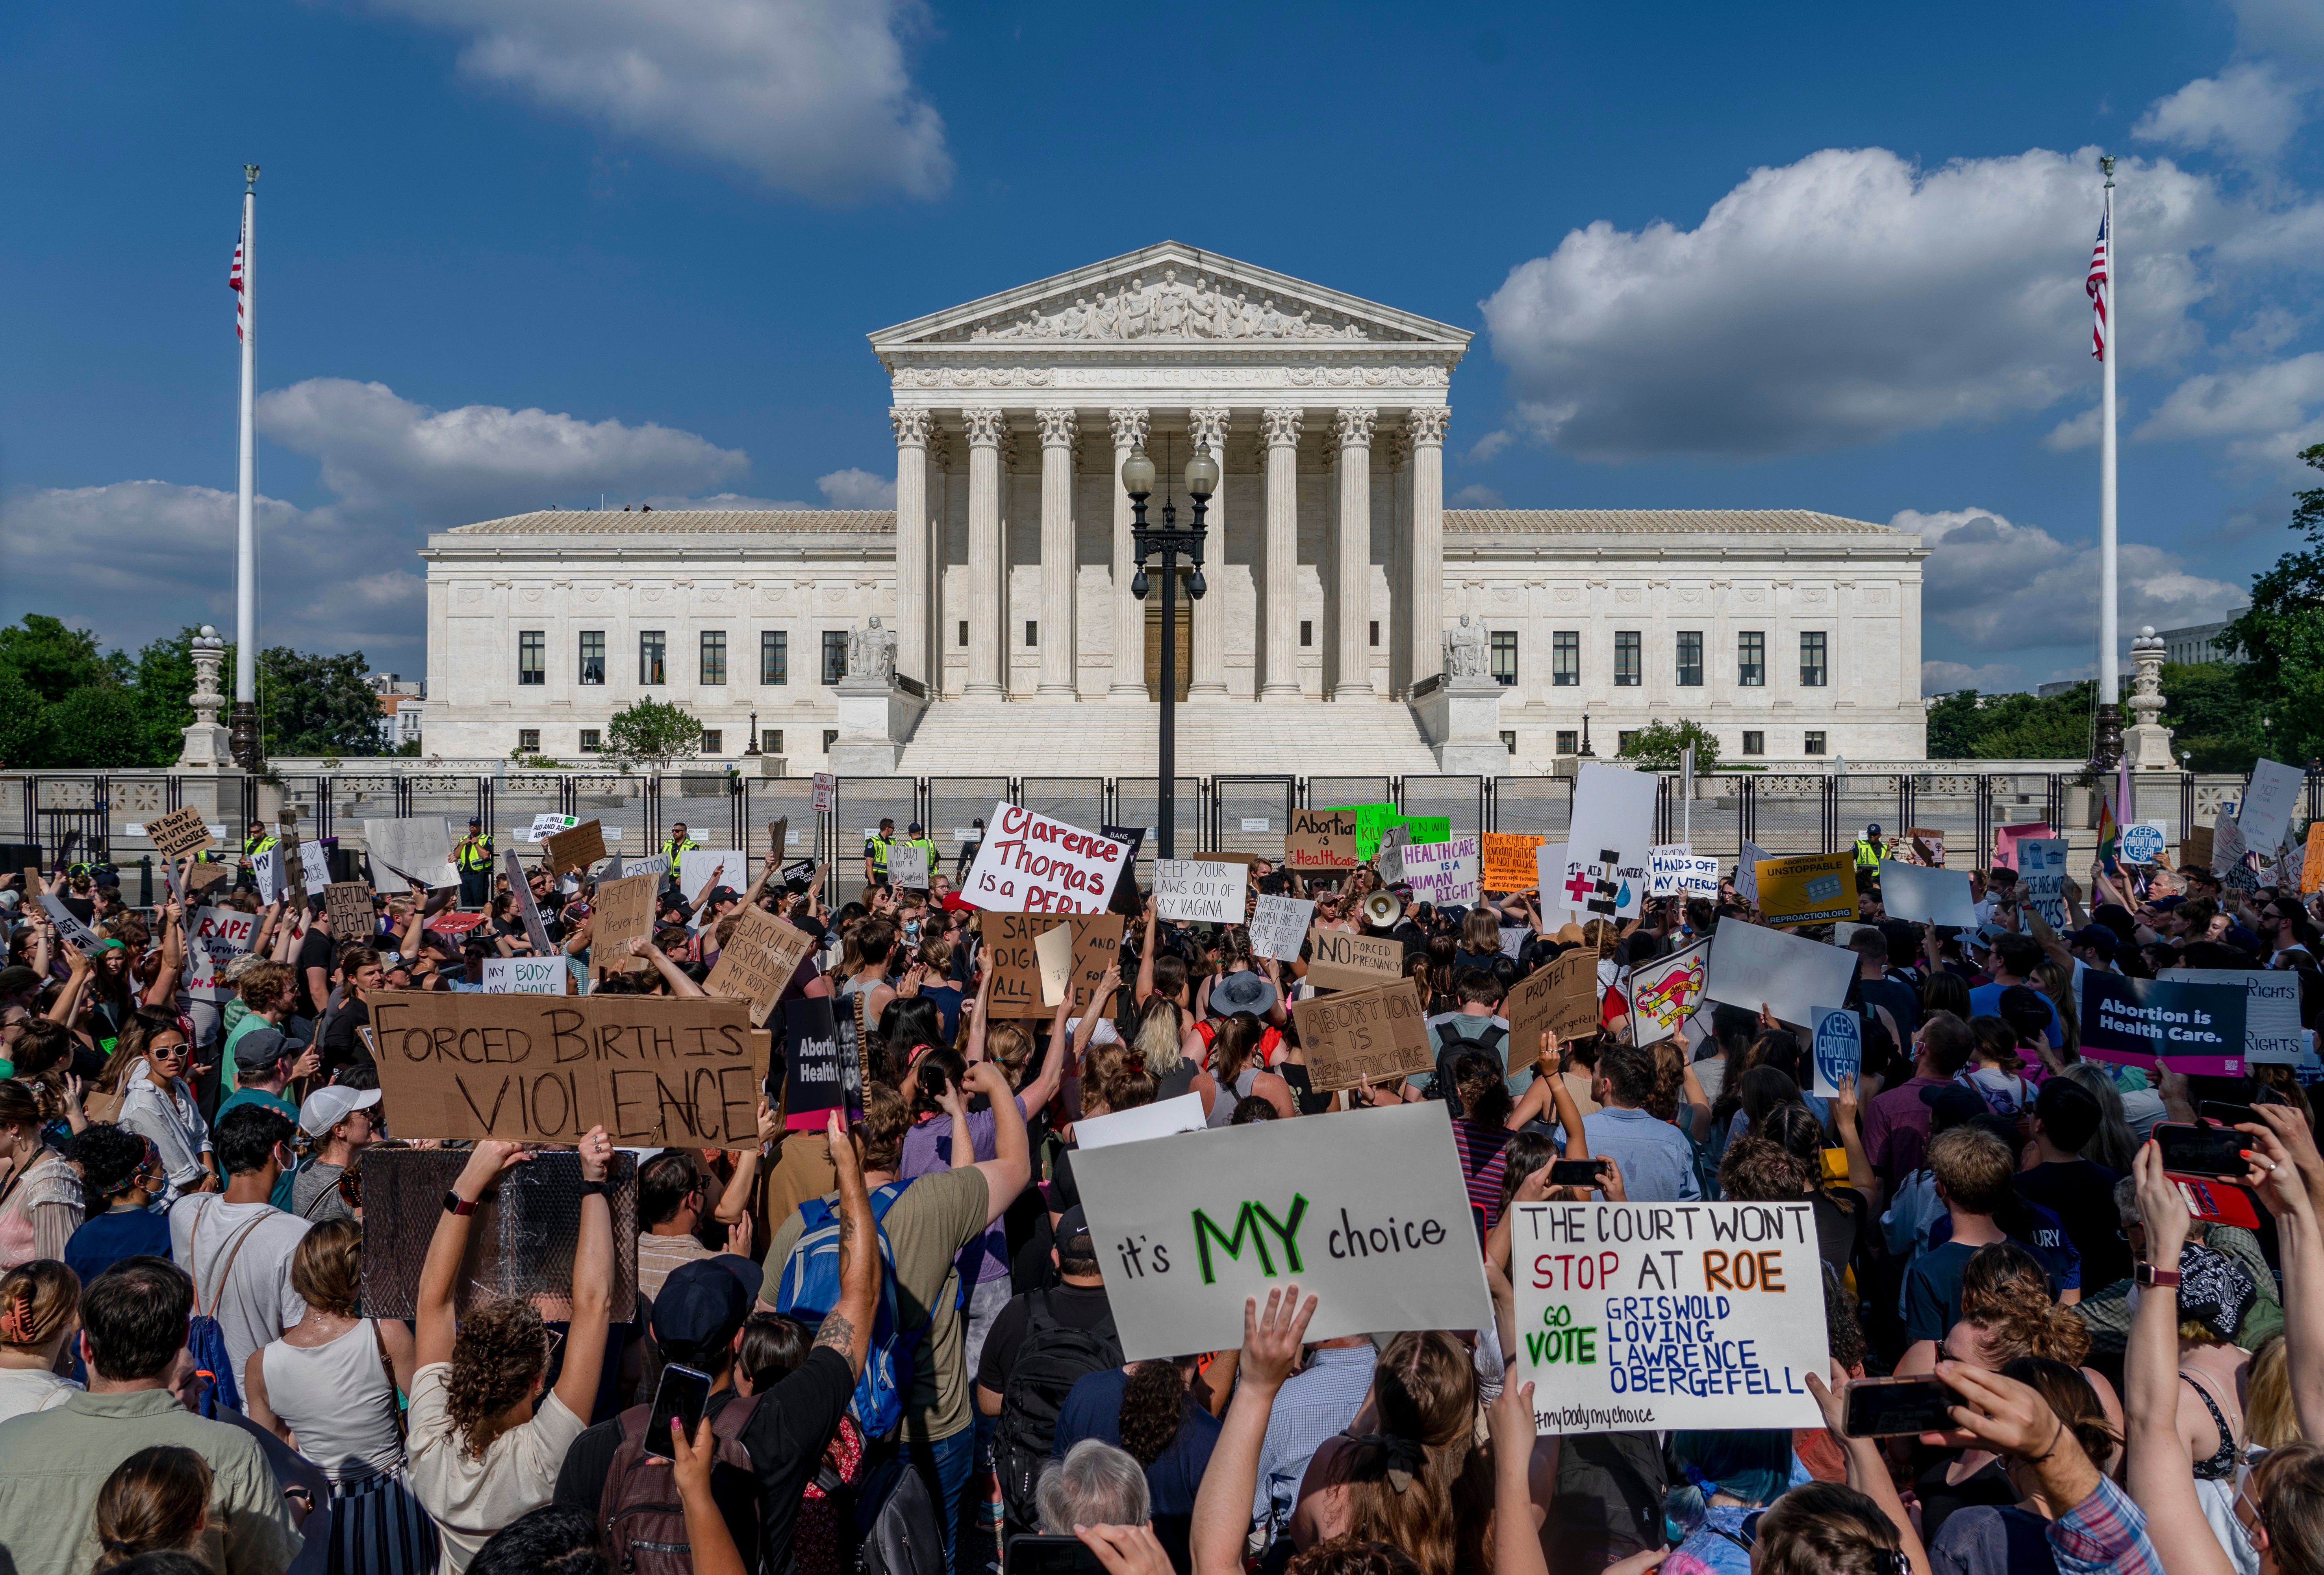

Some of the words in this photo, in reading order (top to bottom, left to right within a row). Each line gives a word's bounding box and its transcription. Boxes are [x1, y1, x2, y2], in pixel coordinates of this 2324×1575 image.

[1066, 371, 1116, 382] EQUAL
[1120, 371, 1180, 382] JUSTICE
[1188, 371, 1240, 382] UNDER
[1245, 371, 1274, 382] LAW
[2260, 764, 2271, 780] I
[2260, 784, 2278, 795] NOT
[147, 821, 162, 835] MY
[153, 832, 168, 845] MY
[168, 817, 203, 838] UTERUS
[379, 822, 413, 842] AIDS
[423, 832, 438, 840] AND
[1294, 812, 1356, 835] Abortion
[1431, 822, 1451, 832] WILL
[2132, 827, 2157, 837] KEEP
[160, 843, 176, 856] MY
[174, 826, 209, 847] CHOICE
[1003, 807, 1118, 862] Clarence
[1318, 834, 1329, 845] is
[1530, 836, 1540, 847] the
[2125, 836, 2161, 848] ABORTION
[382, 842, 428, 862] ABETS
[893, 847, 902, 860] MY
[1404, 838, 1475, 864] HEALTHCARE
[2229, 838, 2246, 854] US
[254, 854, 269, 871] MY
[995, 839, 1104, 895] Thomas
[1296, 849, 1356, 867] Healthcare
[1441, 862, 1450, 871] IS
[1453, 860, 1460, 870] A
[1486, 855, 1494, 864] did
[1497, 857, 1511, 866] NOT
[1653, 857, 1692, 873] HANDS
[1695, 860, 1717, 873] OFF
[784, 863, 808, 876] ABORTION
[786, 870, 804, 880] JUSTICE
[800, 870, 815, 880] CAN'T
[1155, 860, 1189, 878] KEEP
[1197, 861, 1227, 877] YOUR
[1587, 865, 1602, 876] AID
[1616, 867, 1644, 879] WATER
[1767, 861, 1842, 876] UNSTOPPABLE
[2304, 861, 2322, 876] GO
[979, 869, 996, 892] is
[1000, 880, 1014, 898] a
[1154, 880, 1187, 894] LAWS
[1194, 882, 1216, 895] OUT
[1221, 884, 1235, 897] OF
[1407, 871, 1453, 890] HUMAN
[1654, 875, 1673, 890] MY
[1677, 877, 1718, 891] UTERUS
[2039, 875, 2050, 894] ARE
[2051, 876, 2064, 894] NOT
[325, 886, 371, 905] ABORTION
[599, 878, 657, 911] VASECTOMY
[1436, 881, 1474, 903] RIGHT
[339, 906, 348, 914] IS
[1156, 898, 1175, 914] MY
[1181, 899, 1222, 918] VAGINA
[1258, 896, 1281, 910] WHEN
[1284, 900, 1297, 913] WILL
[331, 912, 373, 935] RIGHT
[605, 911, 644, 934] Prevents
[1255, 911, 1278, 925] WOMEN
[1280, 913, 1293, 926] HAVE
[1295, 915, 1306, 927] THE
[1770, 909, 1850, 924] REPROACTION.ORG
[197, 917, 252, 940] RAPE
[1250, 924, 1272, 939] SAME
[1274, 926, 1299, 944] RIGHTS
[737, 915, 805, 966] EJACULATE
[1090, 937, 1116, 950] AND
[1262, 941, 1288, 959] GUNS?
[1317, 934, 1351, 964] NO
[1354, 941, 1391, 956] FORCED
[727, 935, 792, 986] RESPONSIBLY
[1352, 953, 1402, 972] PREGNANCY
[489, 965, 505, 979] MY
[516, 964, 554, 981] BODY
[729, 963, 744, 981] MY
[1526, 957, 1579, 1004] PROTECT
[489, 982, 507, 993] MY
[514, 983, 557, 994] CHOICE
[719, 980, 738, 997] MY
[993, 975, 1031, 997] ALL
[2247, 977, 2295, 999] RIGHTS
[1657, 996, 1666, 1004] I
[1306, 993, 1420, 1034] ABORTION
[1514, 1002, 1547, 1032] Griswold
[1540, 1003, 1571, 1031] Lawrence
[2100, 998, 2188, 1023] Abortion
[2194, 1010, 2211, 1025] is
[374, 1003, 532, 1064] FORCED
[540, 1008, 677, 1064] BIRTH
[684, 1024, 743, 1057] IS
[1825, 1014, 1853, 1037] KEEP
[2100, 1015, 2163, 1039] Health
[2168, 1027, 2223, 1043] Care.
[799, 1035, 836, 1057] Abortio
[1349, 1027, 1372, 1049] IS
[2244, 1030, 2299, 1052] RIGHTS
[1819, 1036, 1859, 1061] ABORTION
[800, 1062, 835, 1082] Health
[1310, 1046, 1427, 1086] HEALTHCARE
[455, 1065, 758, 1143] VIOLENCE
[1519, 1207, 1586, 1243] THE
[1597, 1206, 1701, 1242] COURT
[1708, 1205, 1810, 1244] WON'T
[1117, 1235, 1170, 1280] it's
[1190, 1192, 1309, 1285] MY
[1329, 1208, 1447, 1260] choice
[1533, 1251, 1619, 1291] STOP
[1638, 1250, 1684, 1290] AT
[1702, 1249, 1787, 1293] ROE
[1544, 1305, 1572, 1327] GO
[1606, 1295, 1730, 1321] GRISWOLD
[1607, 1320, 1715, 1343] LOVING
[1526, 1326, 1597, 1367] VOTE
[1608, 1339, 1759, 1370] LAWRENCE
[1610, 1366, 1805, 1397] OBERGEFELL
[1535, 1403, 1655, 1433] #mybodymychoice
